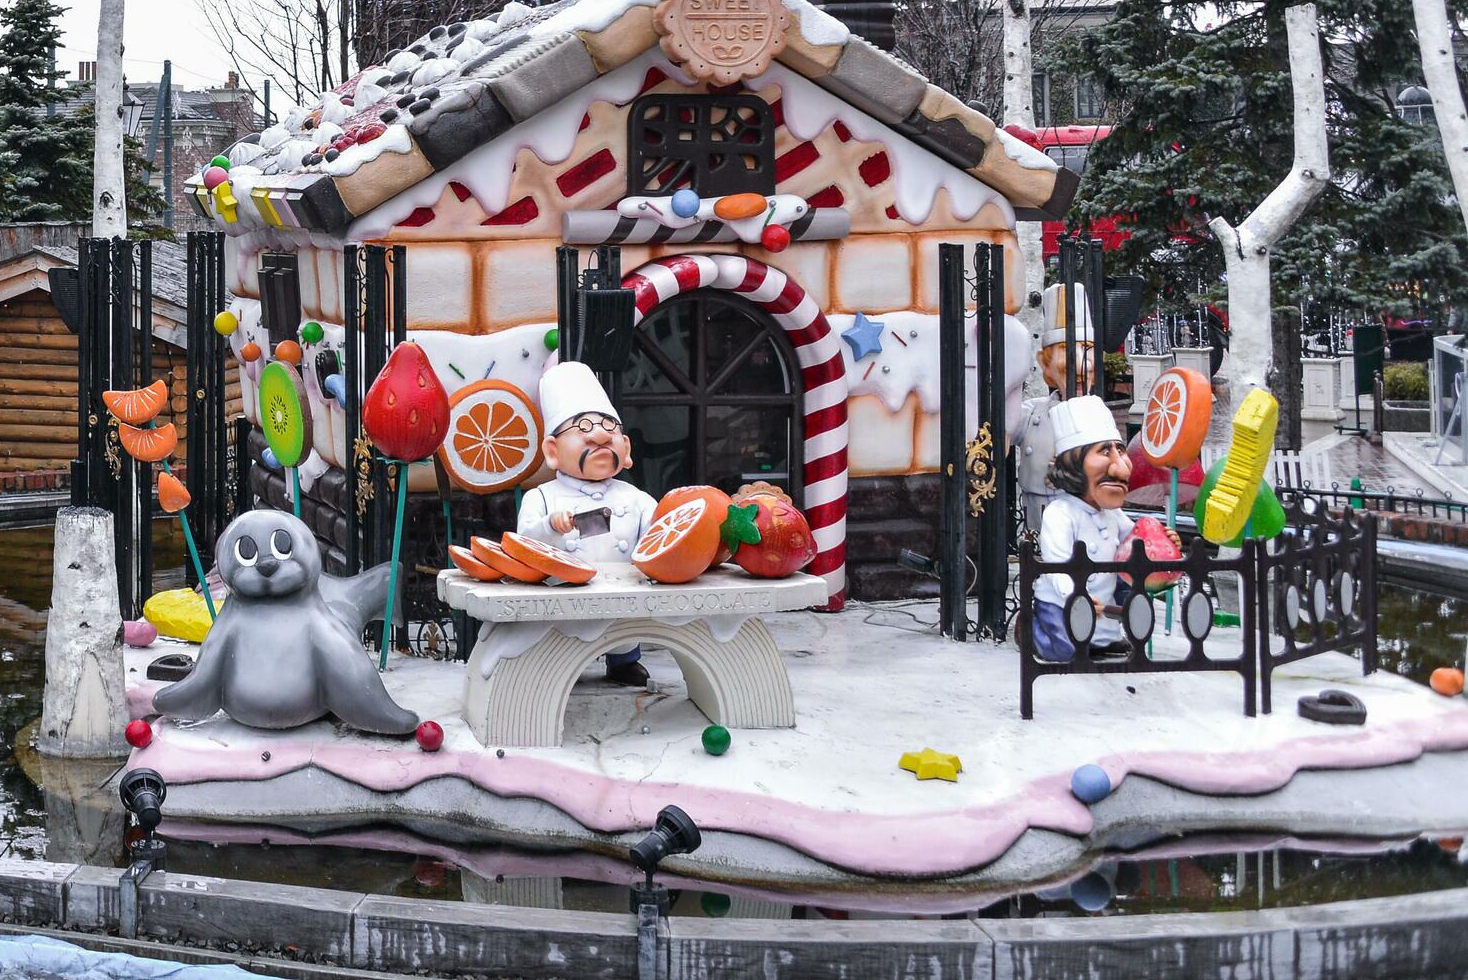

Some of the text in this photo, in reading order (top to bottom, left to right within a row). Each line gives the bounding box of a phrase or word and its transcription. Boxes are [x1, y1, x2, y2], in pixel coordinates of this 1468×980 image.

[692, 23, 765, 41] HOUSE
[497, 591, 771, 617] ISHIYA WHITE CHOCOLATE
